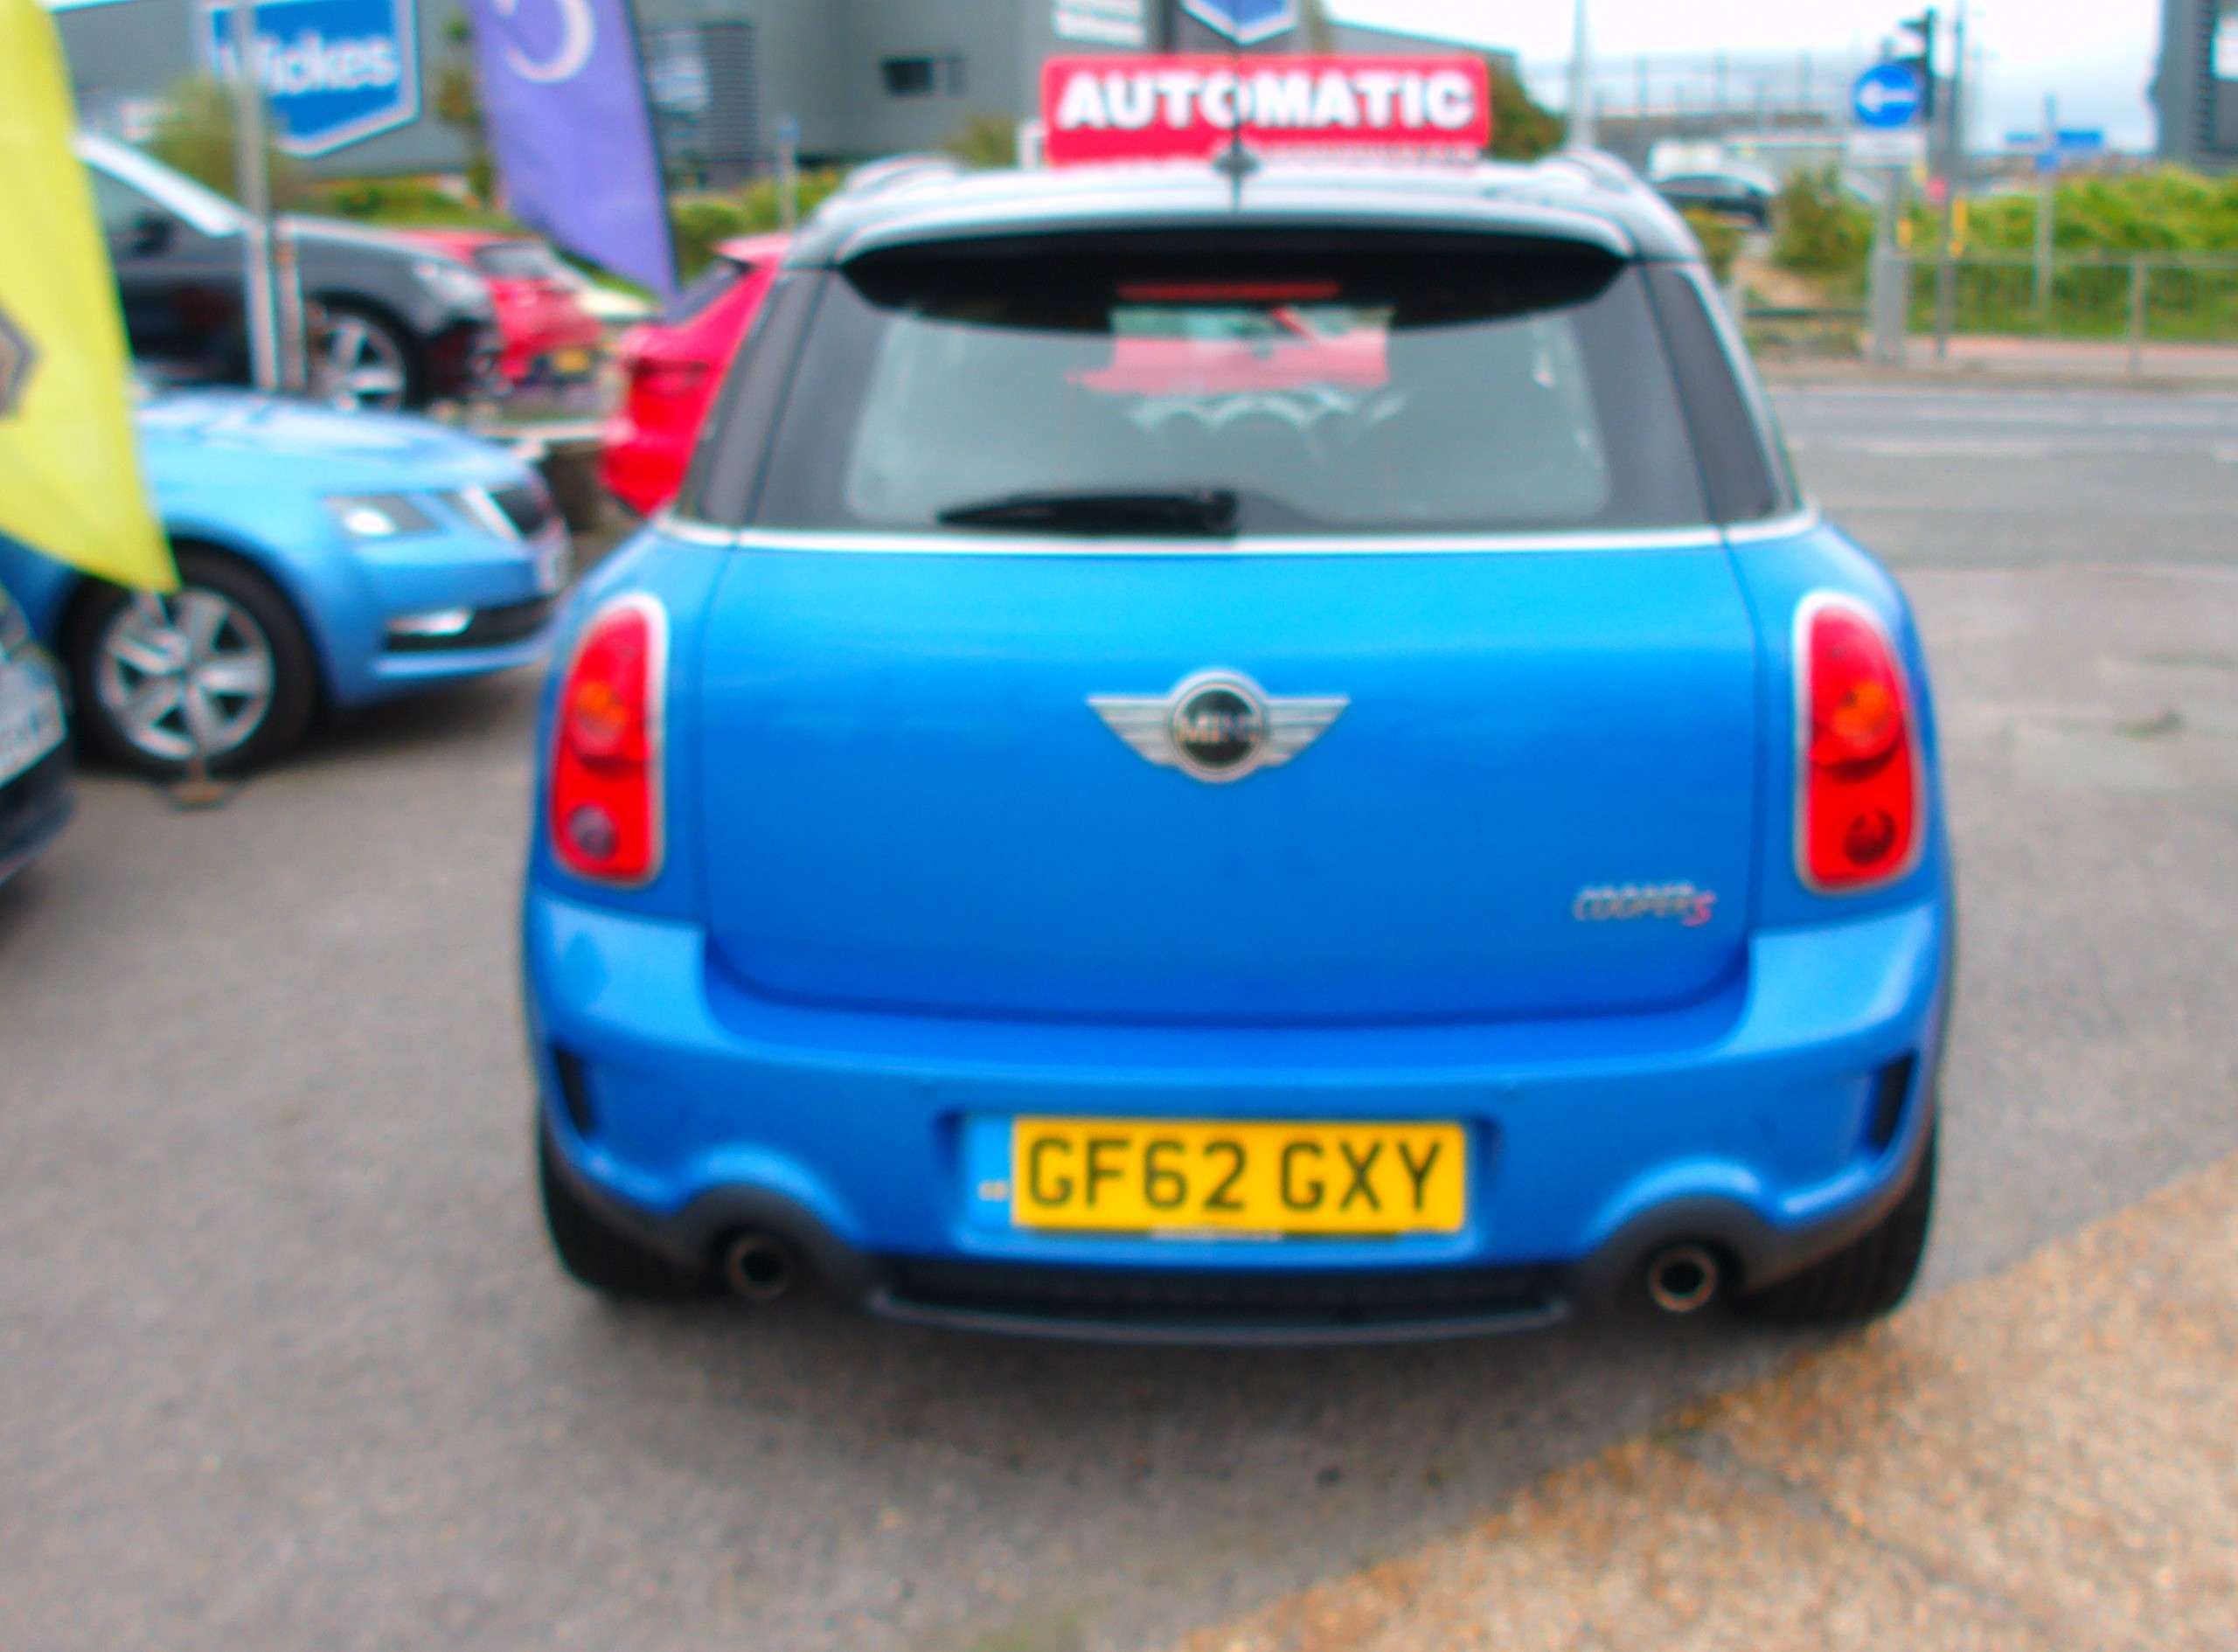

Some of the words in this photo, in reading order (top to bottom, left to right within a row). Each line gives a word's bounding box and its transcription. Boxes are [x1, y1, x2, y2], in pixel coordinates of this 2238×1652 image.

[1057, 70, 1475, 129] AUTOMATIC
[1027, 1137, 1246, 1212] GF62
[1278, 1141, 1442, 1213] GXY
